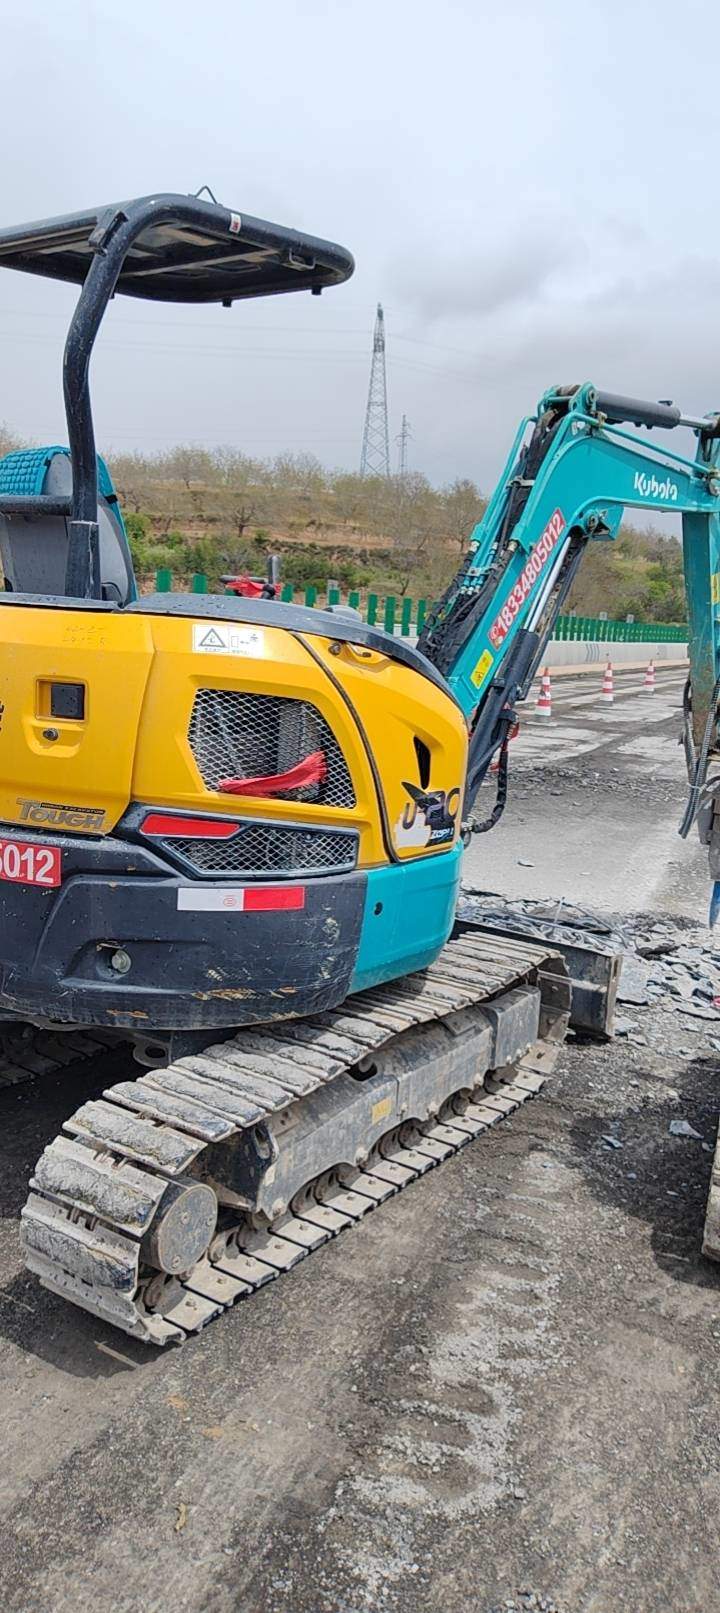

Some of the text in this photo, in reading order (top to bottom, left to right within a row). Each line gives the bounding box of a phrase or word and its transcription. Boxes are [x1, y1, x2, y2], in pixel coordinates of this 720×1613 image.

[634, 472, 678, 500] Kubota
[497, 513, 565, 633] 18334805012
[16, 798, 105, 828] TOUGH
[0, 844, 54, 883] 012
